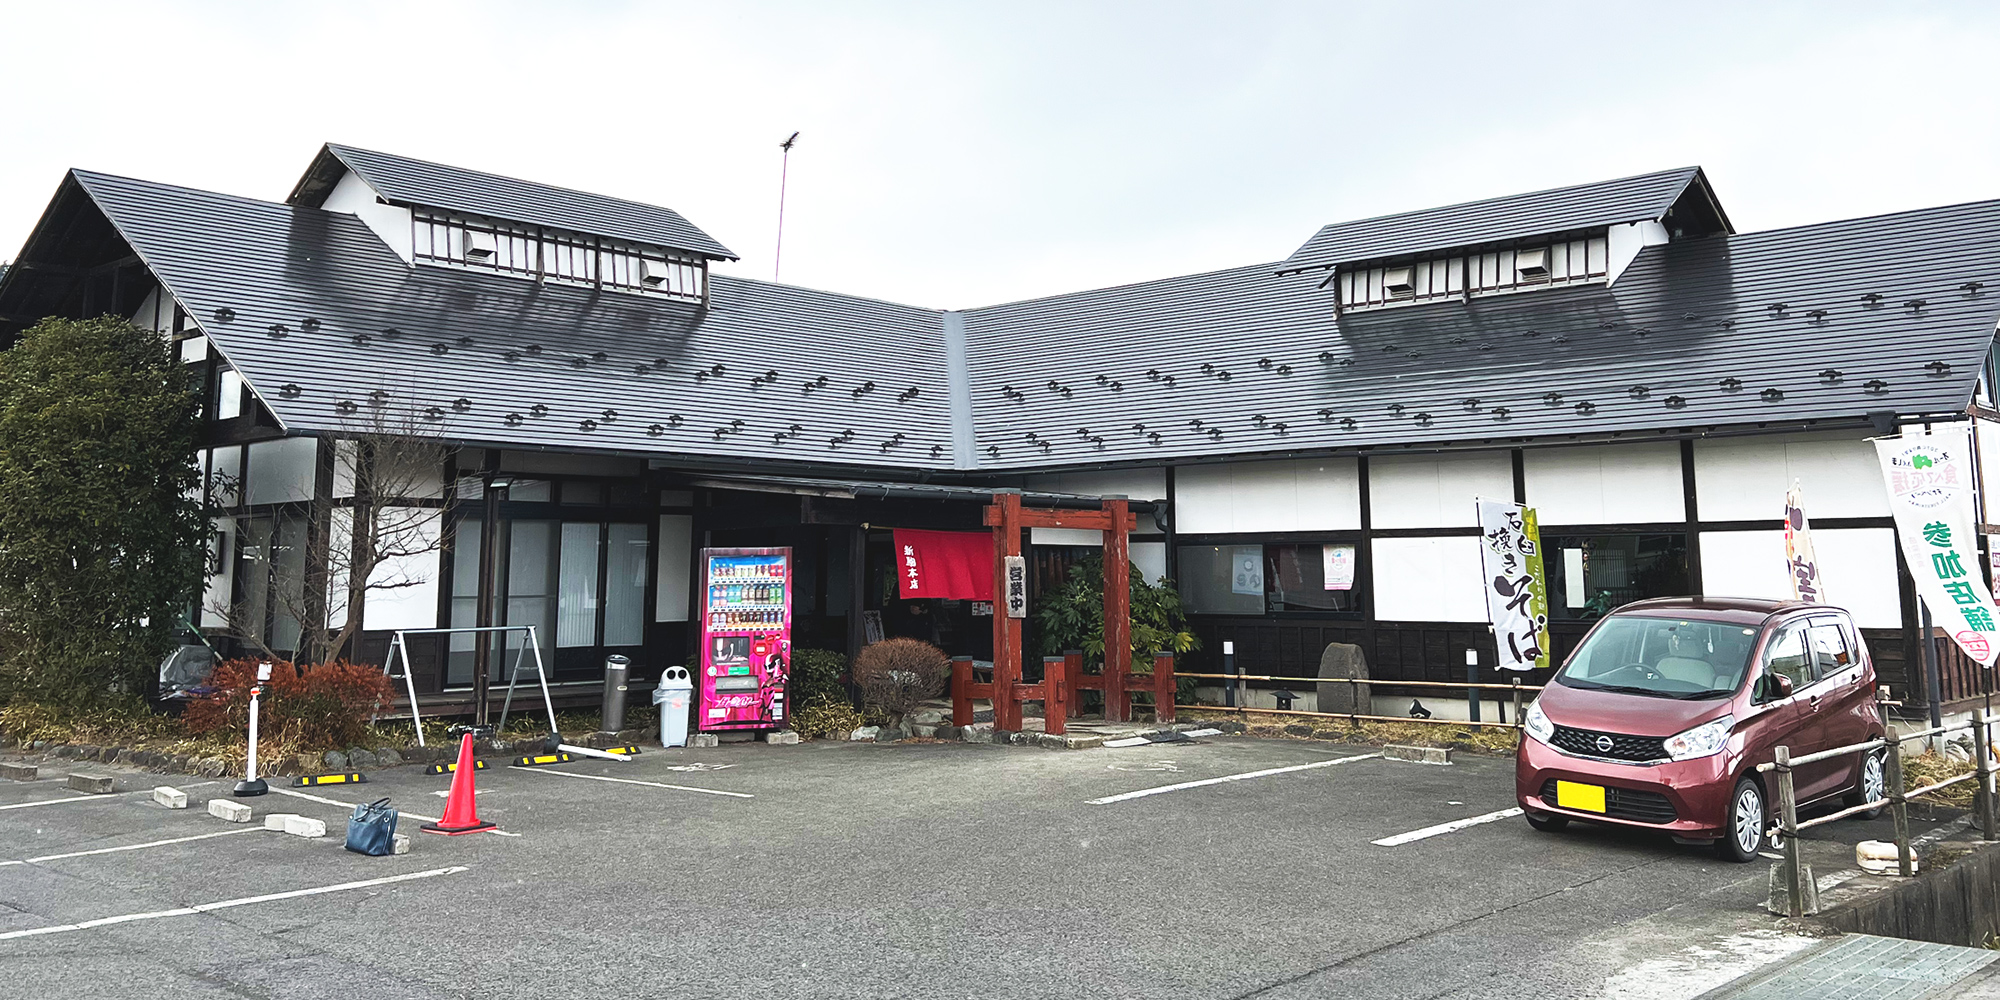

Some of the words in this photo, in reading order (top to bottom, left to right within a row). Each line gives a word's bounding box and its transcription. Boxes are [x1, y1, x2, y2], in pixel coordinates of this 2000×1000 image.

[1009, 566, 1024, 612] 営業中
[1494, 575, 1546, 664] そば
